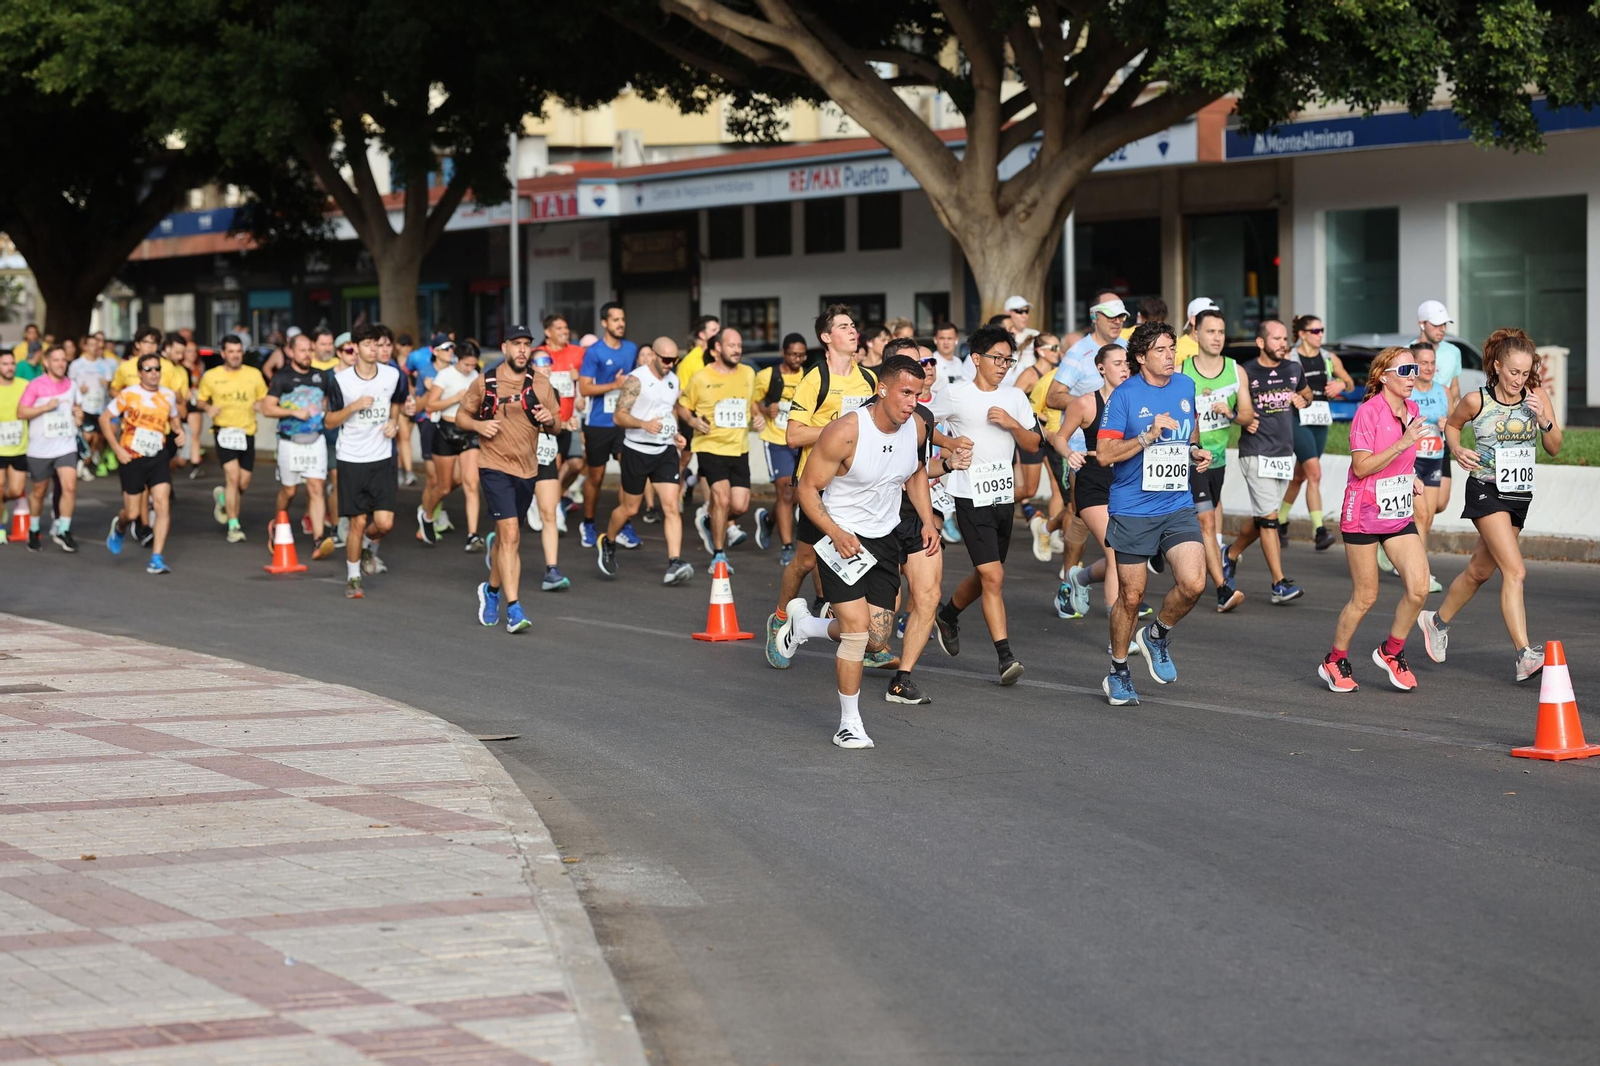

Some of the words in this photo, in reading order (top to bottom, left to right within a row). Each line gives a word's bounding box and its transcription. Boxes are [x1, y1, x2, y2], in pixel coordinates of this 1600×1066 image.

[1267, 129, 1354, 153] MonteAlminara
[788, 166, 842, 192] RE/MAX
[844, 165, 889, 188] Puerto
[358, 408, 387, 420] 5032
[718, 411, 745, 421] 1119
[1304, 413, 1330, 424] 7366
[1497, 434, 1532, 442] WOMAN
[1147, 464, 1187, 478] 10206
[1262, 458, 1291, 471] 7405
[1501, 467, 1533, 483] 2108
[974, 477, 1013, 494] 10935
[1382, 493, 1412, 511] 2110
